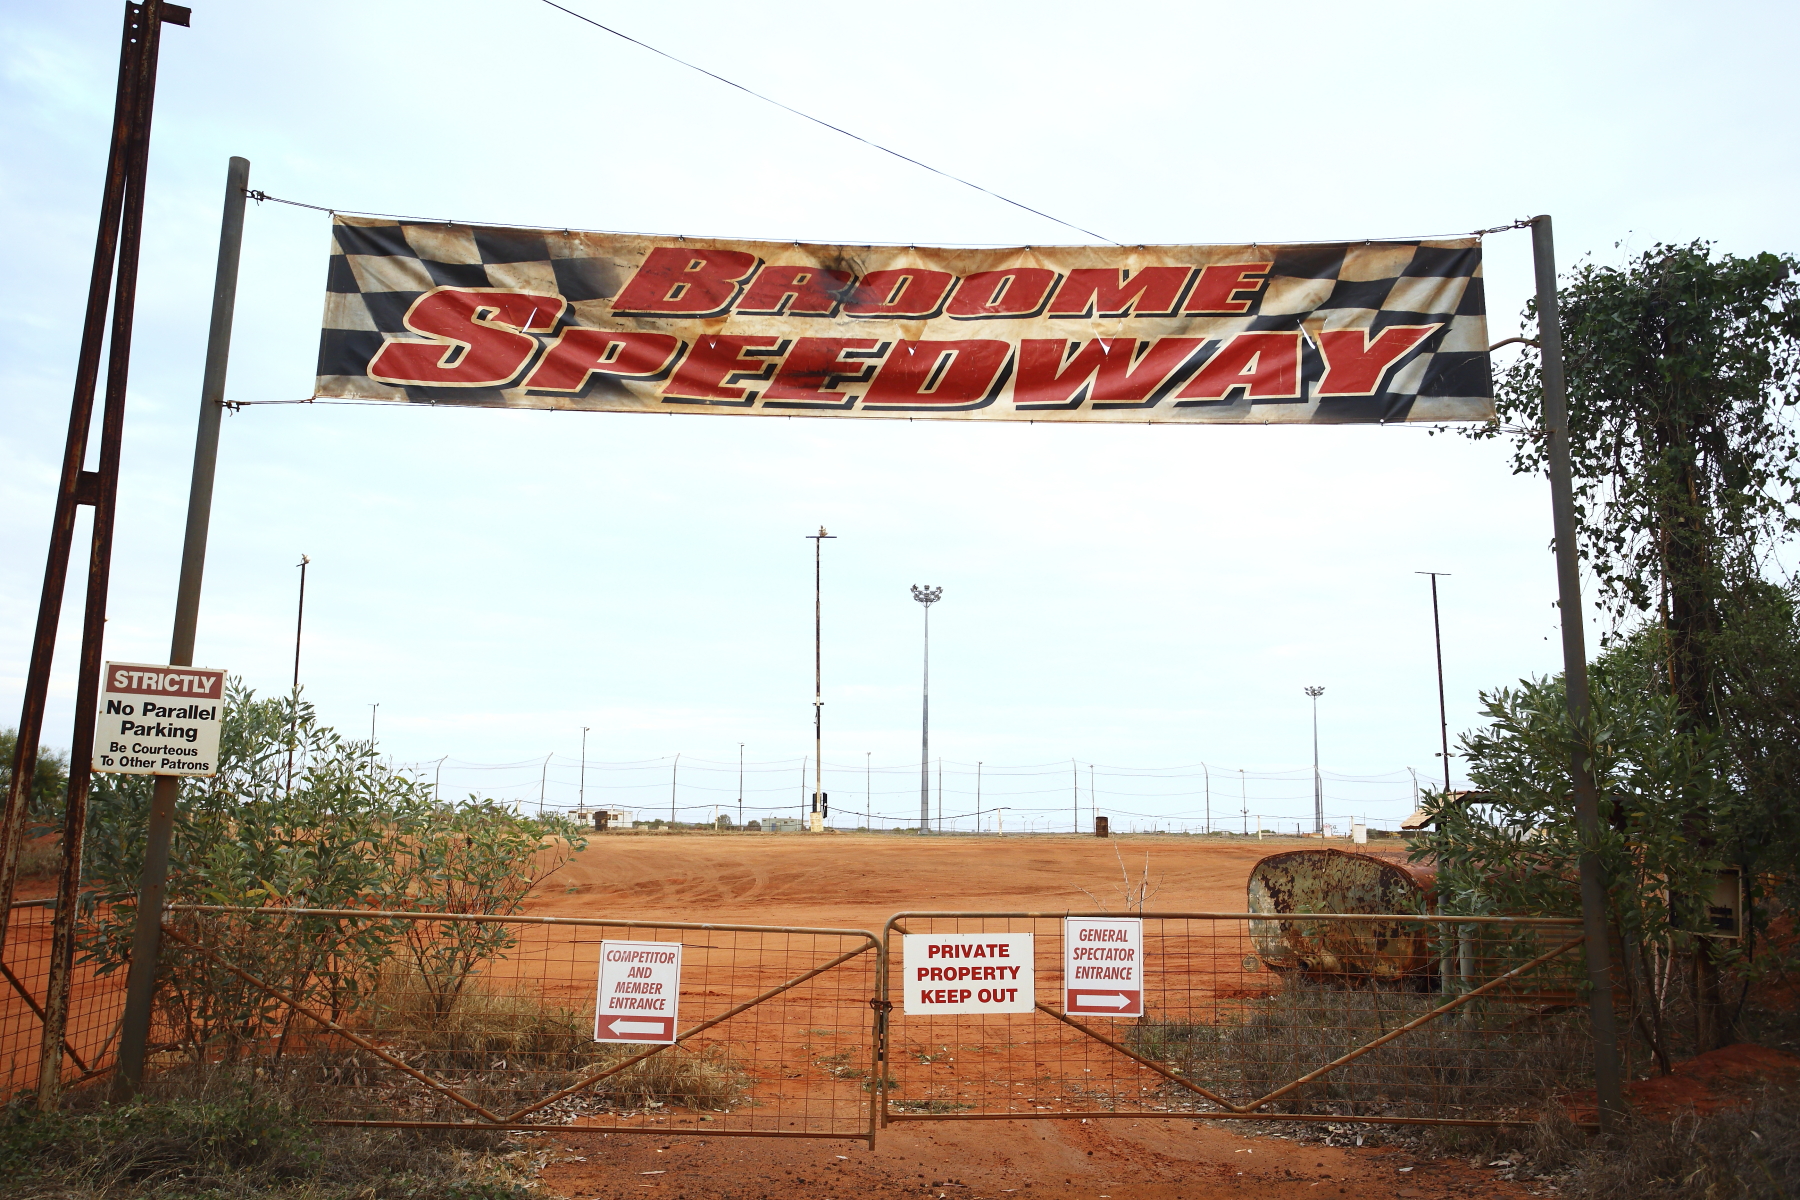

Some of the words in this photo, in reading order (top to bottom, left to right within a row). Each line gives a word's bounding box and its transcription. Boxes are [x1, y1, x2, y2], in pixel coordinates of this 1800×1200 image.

[611, 246, 1274, 319] BROOME
[366, 285, 1450, 411] SPEEDWAY
[113, 670, 217, 694] STRICTLY
[106, 700, 134, 716] No
[142, 702, 217, 721] Parallel
[120, 720, 198, 742] Parking
[109, 742, 127, 753] Be
[132, 743, 198, 756] Courteous
[100, 755, 114, 766] To
[119, 756, 156, 768] Other
[161, 758, 209, 771] Patrons
[1079, 928, 1128, 942] GENERAL
[606, 950, 676, 964] COMPETITOR
[928, 943, 1010, 959] PRIVATE
[1073, 947, 1135, 961] SPECTATOR
[627, 966, 653, 979] AND
[917, 966, 1021, 982] PROPERTY
[1075, 966, 1133, 980] ENTRANCE
[614, 981, 663, 995] MEMBER
[921, 989, 972, 1004] KEEP
[977, 988, 1018, 1004] OUT
[608, 997, 666, 1011] ENTRANCE
